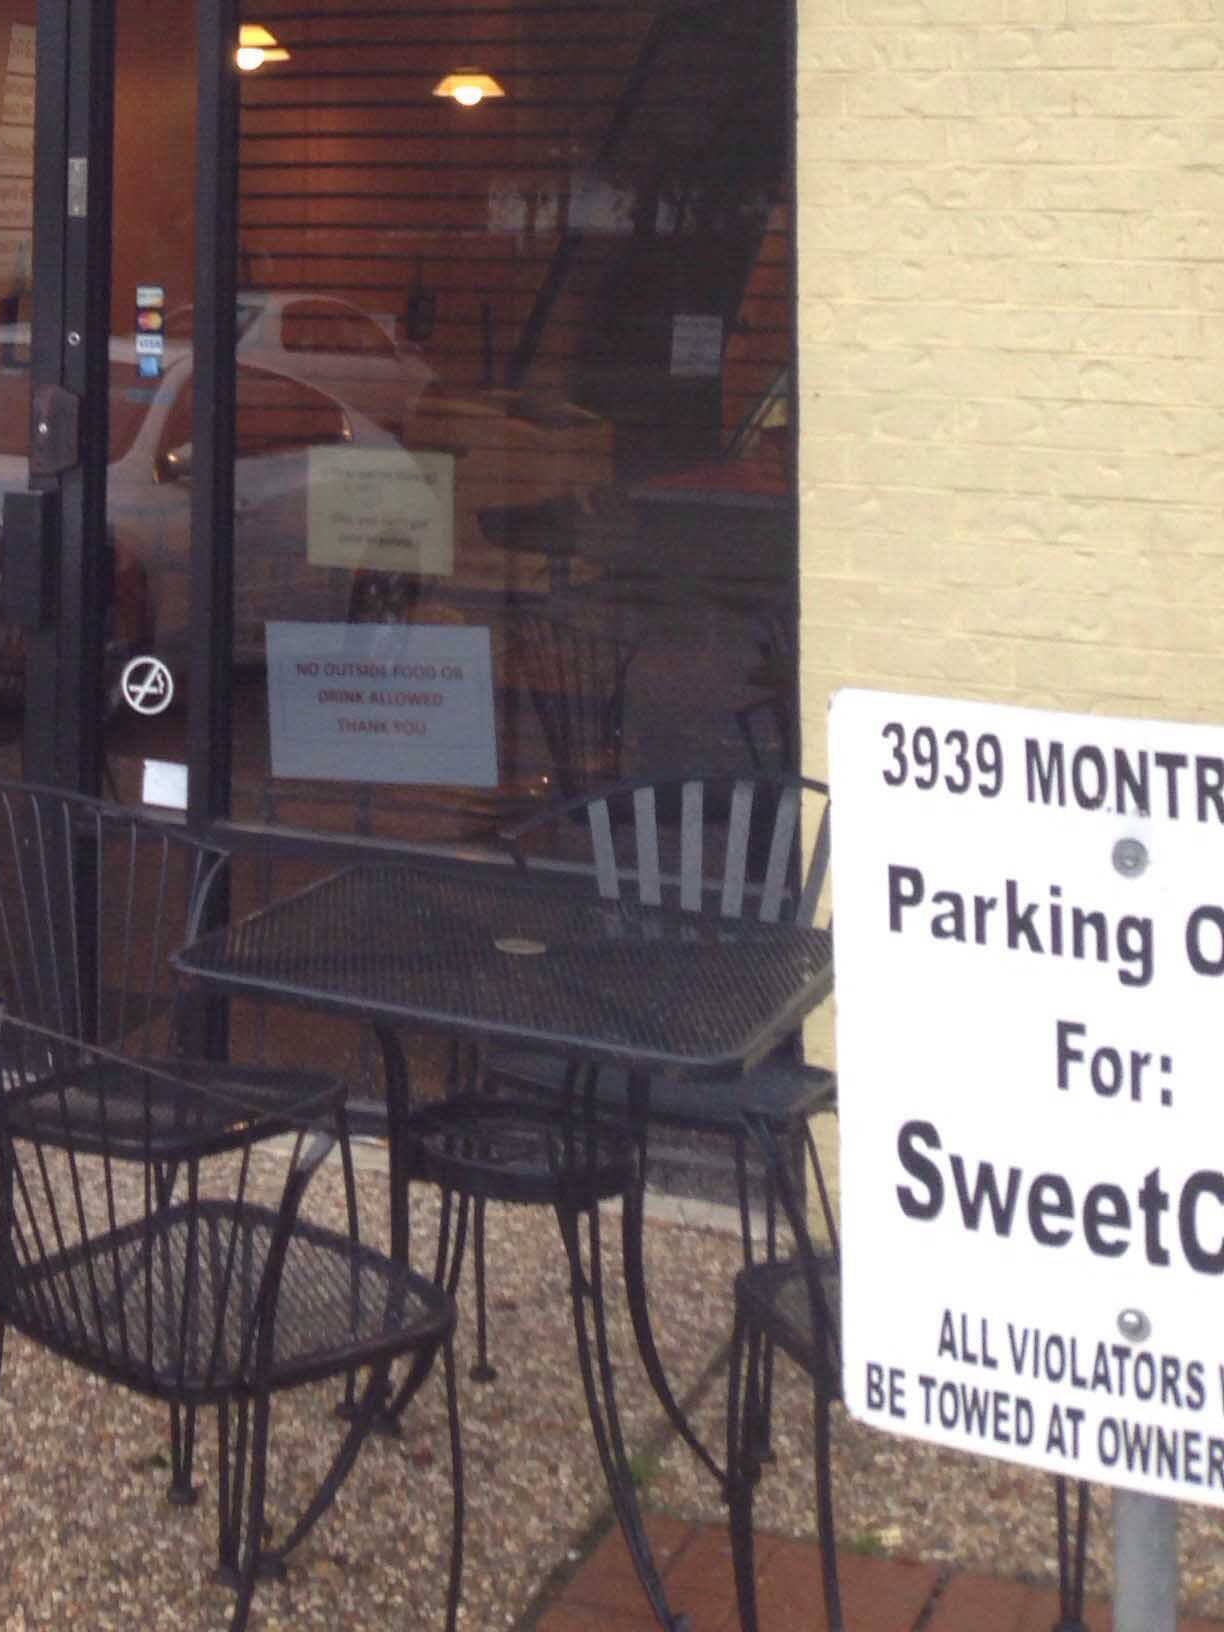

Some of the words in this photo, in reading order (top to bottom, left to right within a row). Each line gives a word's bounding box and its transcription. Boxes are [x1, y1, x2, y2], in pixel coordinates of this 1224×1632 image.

[881, 722, 1004, 798] 3939
[1025, 737, 1224, 824] MONTR
[888, 864, 1154, 988] Parking
[1056, 1019, 1173, 1107] For:
[896, 1119, 1224, 1276] SweetC
[938, 1308, 999, 1369] ALL
[1008, 1323, 1206, 1411] VIOLATORS
[866, 1362, 906, 1419] BE
[919, 1374, 1034, 1447] TOWED
[1046, 1403, 1085, 1460] AT
[1098, 1416, 1224, 1492] OWNER
